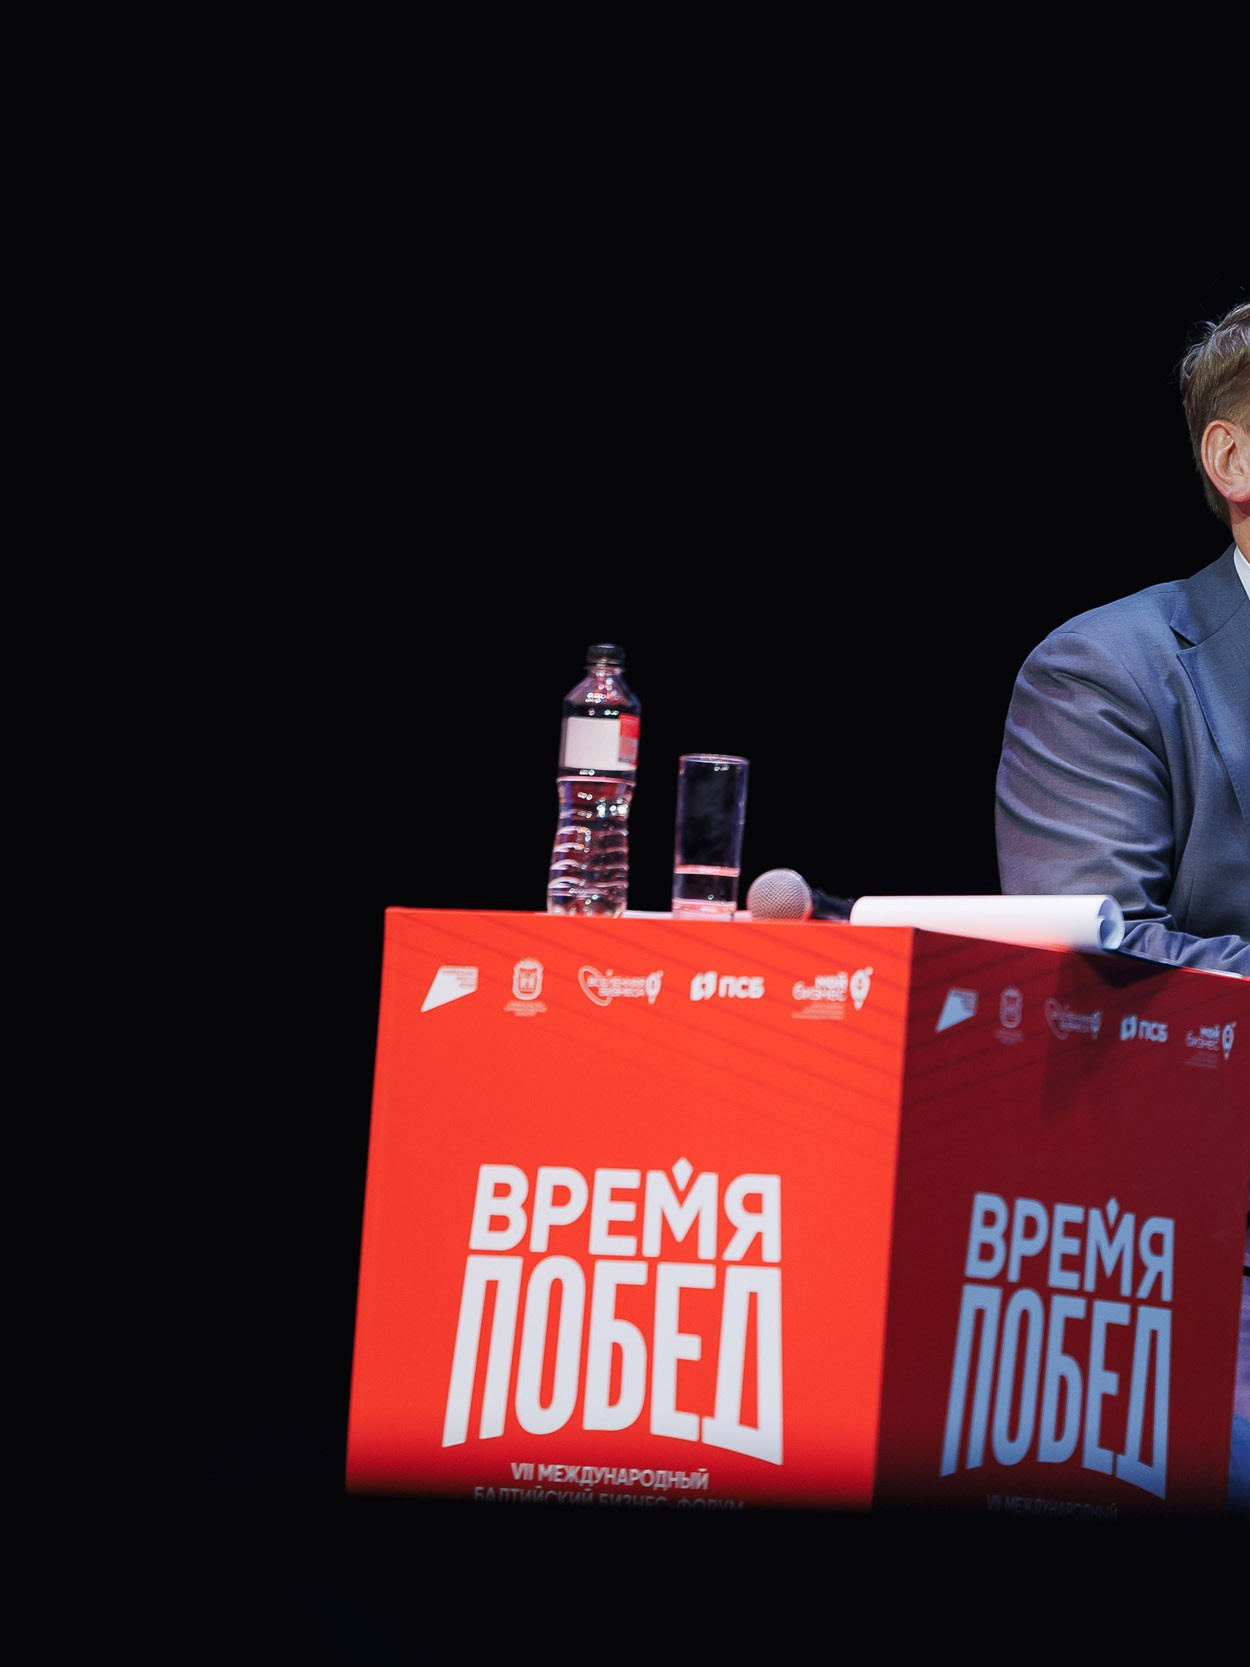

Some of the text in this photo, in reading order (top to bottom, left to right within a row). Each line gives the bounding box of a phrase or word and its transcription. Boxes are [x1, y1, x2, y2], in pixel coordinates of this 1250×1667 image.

[718, 975, 765, 999] ПСБ
[468, 1157, 782, 1263] ВРЕМЯ
[965, 1192, 1175, 1302] ВРЕМЯ
[441, 1254, 783, 1466] ПОБЕД
[940, 1282, 1172, 1499] ПОБЕД
[510, 1462, 709, 1491] VII МЕЖДУНАРОДНЫЙ
